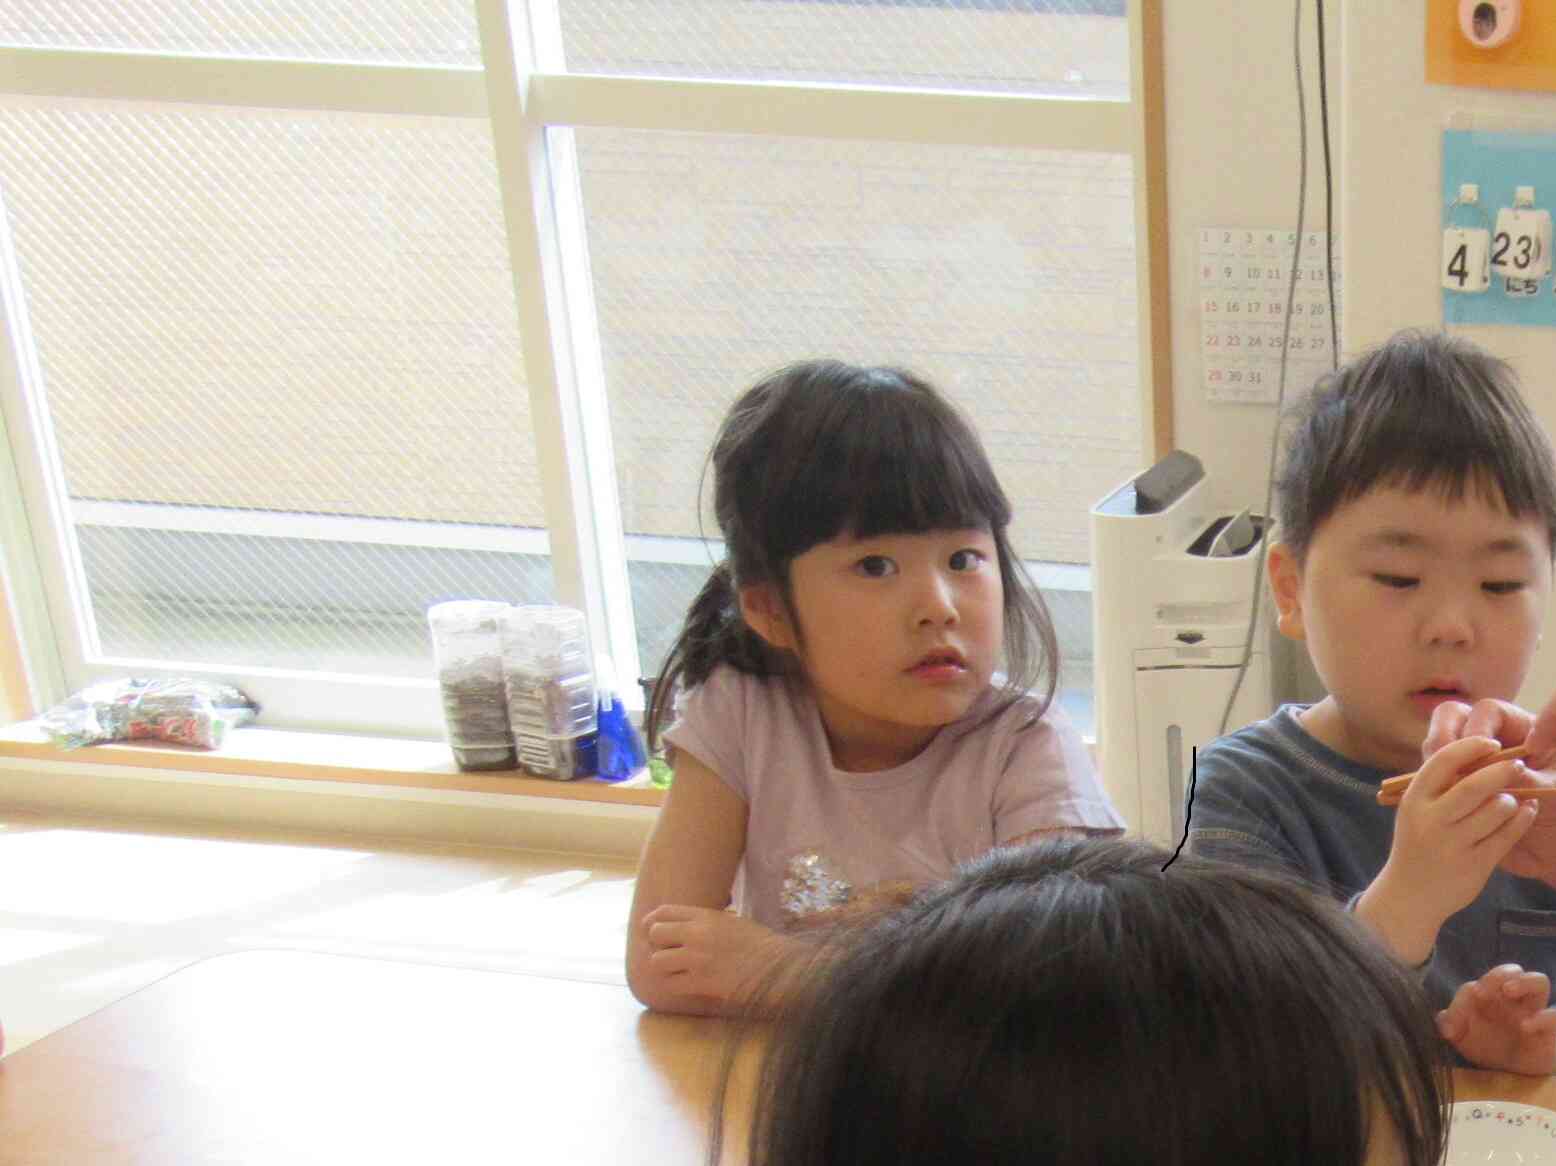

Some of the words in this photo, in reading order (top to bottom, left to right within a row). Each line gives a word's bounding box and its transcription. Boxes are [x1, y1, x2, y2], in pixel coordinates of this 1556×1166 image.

[1223, 231, 1232, 244] 2
[1265, 233, 1274, 244] 4
[1308, 235, 1317, 247] 6
[1448, 244, 1469, 286] 4
[1223, 266, 1233, 279] 9
[1506, 278, 1538, 295] にち
[1226, 301, 1240, 313] 16
[1247, 302, 1261, 313] 17
[1226, 335, 1240, 347] 23
[1247, 335, 1262, 347] 24
[1248, 371, 1262, 384] 31
